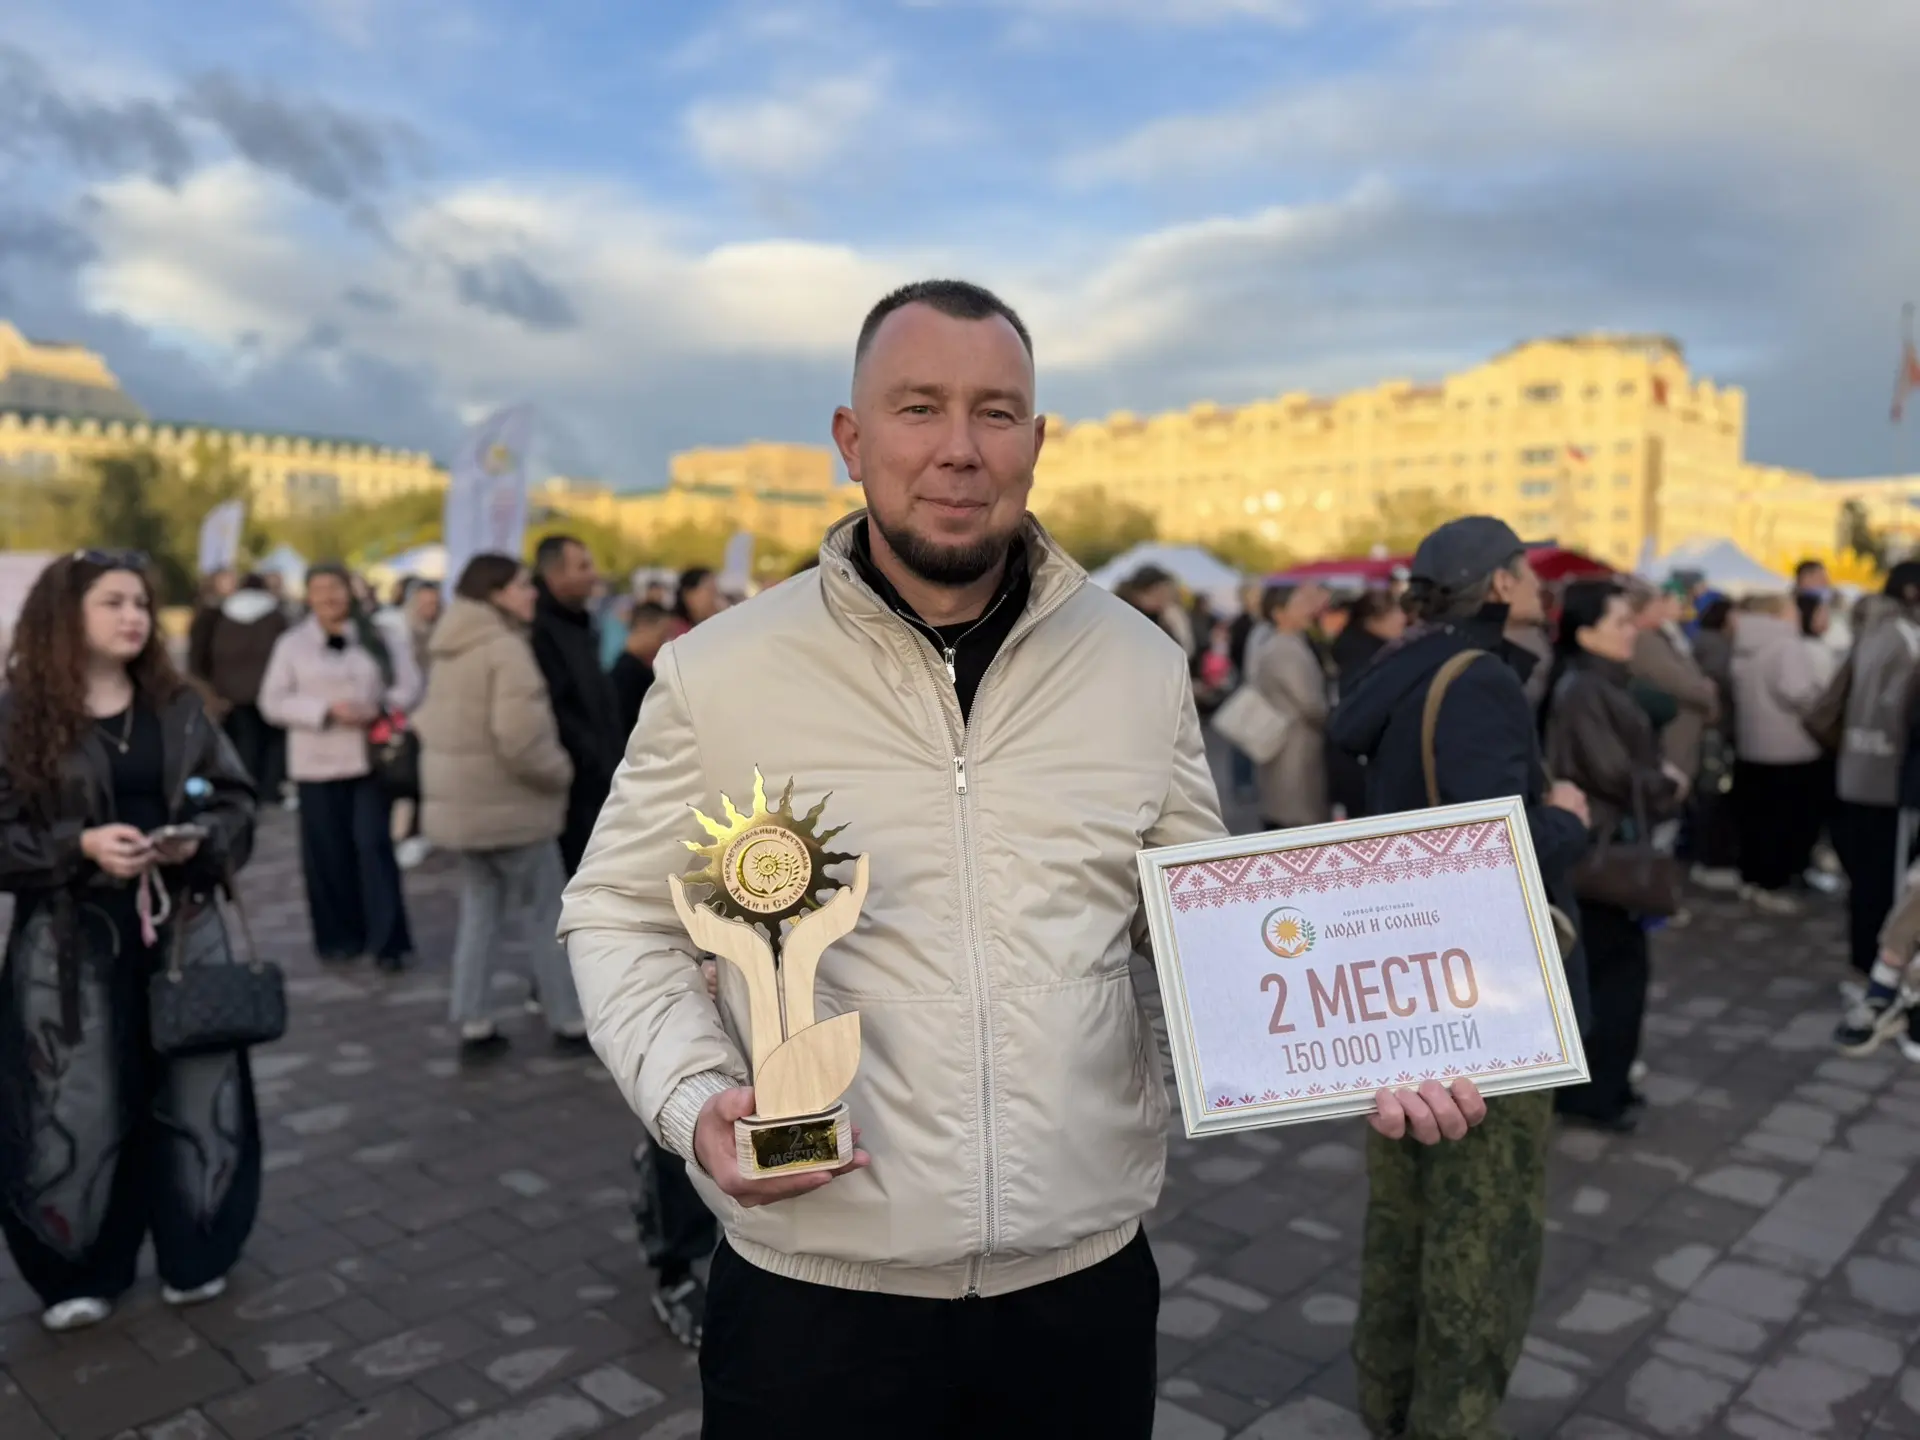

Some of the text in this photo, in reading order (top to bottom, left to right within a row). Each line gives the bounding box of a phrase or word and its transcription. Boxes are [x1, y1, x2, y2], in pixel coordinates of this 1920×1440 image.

[1323, 909, 1441, 940] ЛЮДИ И СОЛНЦЕ
[1259, 947, 1480, 1035] 2 МЕСТО
[1281, 1015, 1482, 1075] 150 000 РУБЛЕЙ
[788, 1125, 804, 1151] 2
